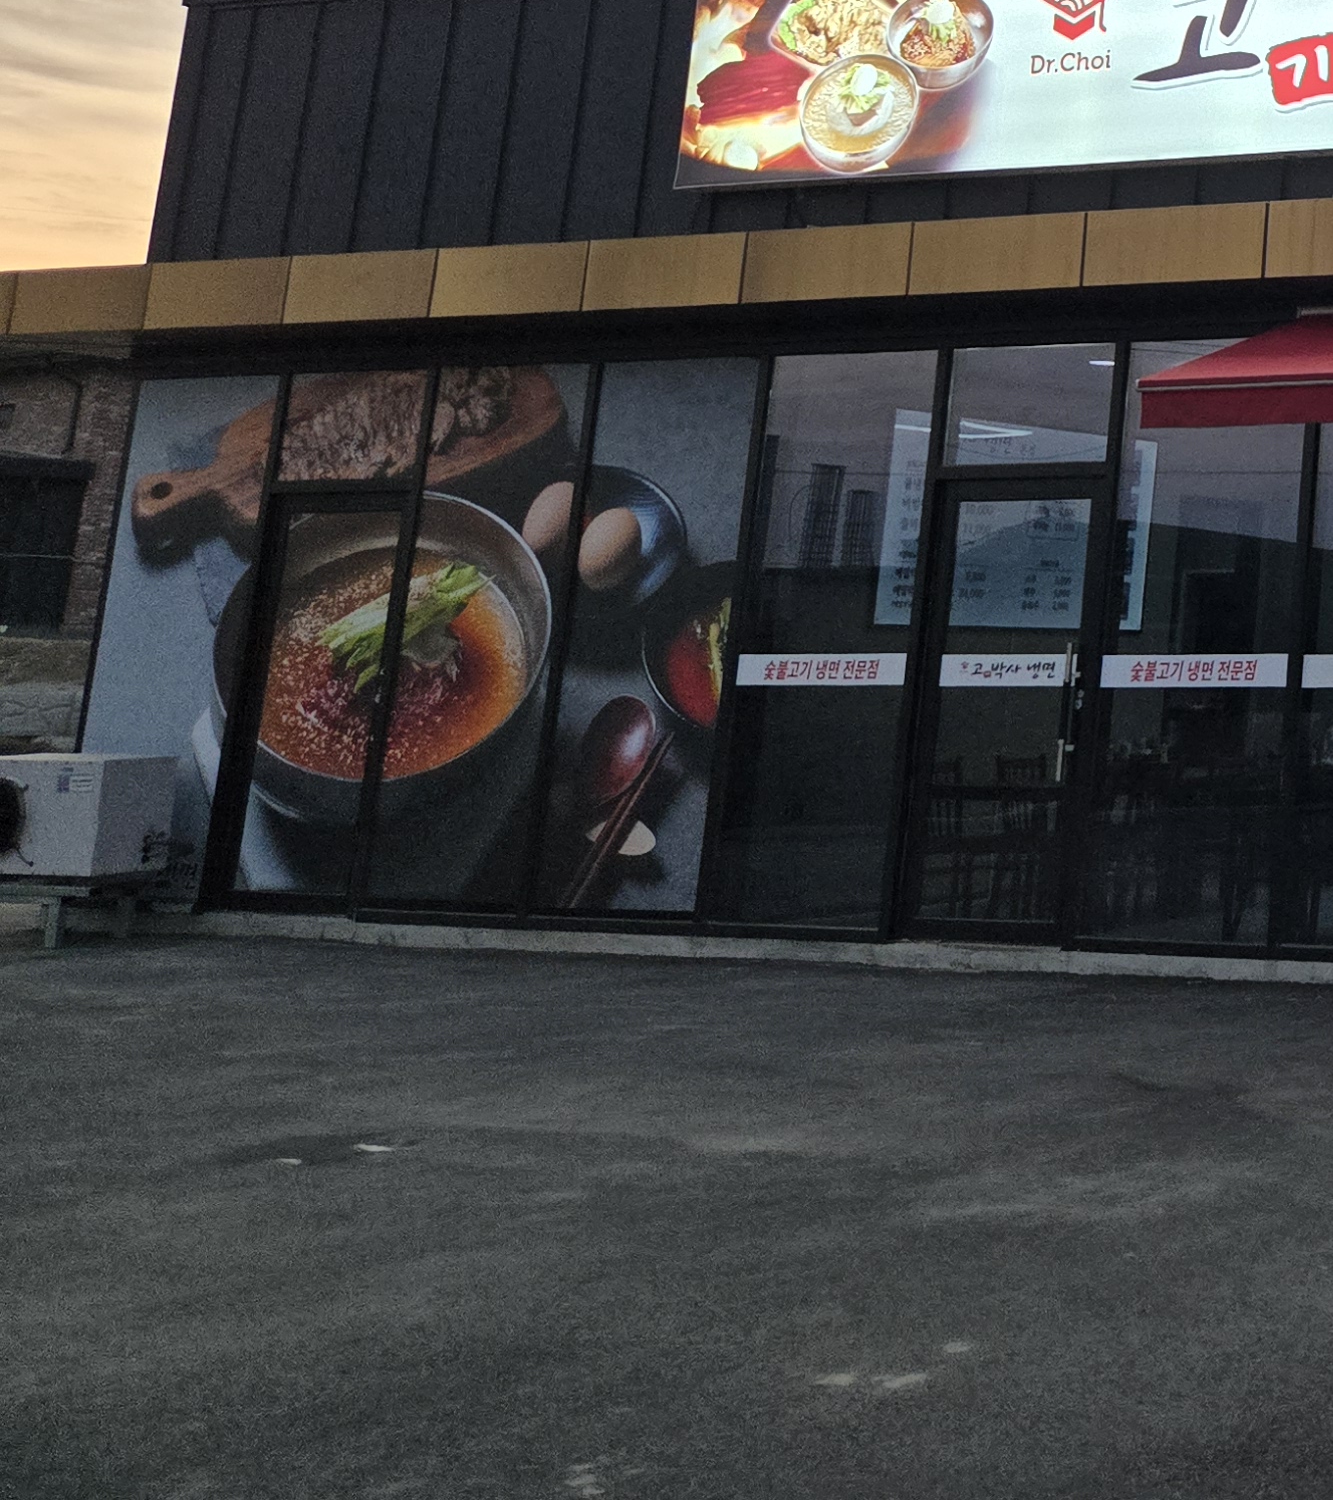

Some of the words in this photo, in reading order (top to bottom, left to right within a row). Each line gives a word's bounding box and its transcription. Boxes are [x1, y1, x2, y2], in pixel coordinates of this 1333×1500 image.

[1029, 48, 1112, 77] Dr.Choi
[763, 659, 812, 681] 숯불고기
[815, 659, 841, 680] 냉면
[842, 658, 881, 681] 전문점
[1026, 660, 1056, 679] 냉면
[1130, 660, 1184, 682] 숯불고기
[1187, 660, 1214, 682] 냉면
[1217, 659, 1258, 681] 전문점
